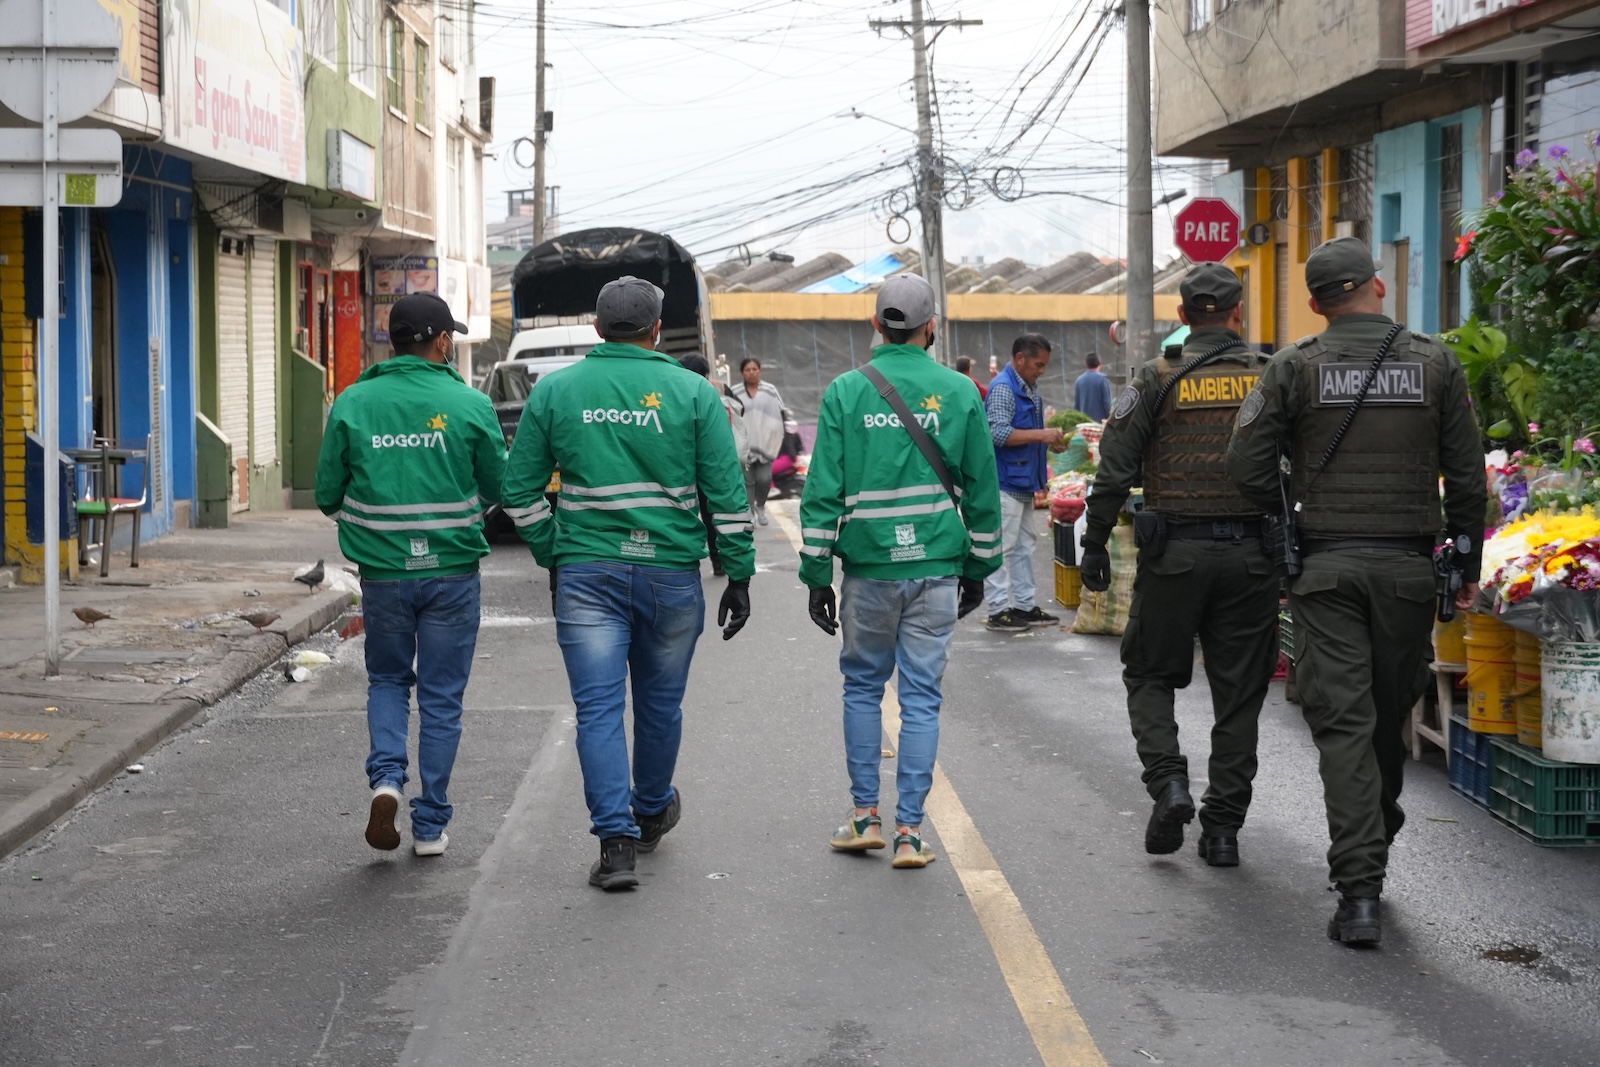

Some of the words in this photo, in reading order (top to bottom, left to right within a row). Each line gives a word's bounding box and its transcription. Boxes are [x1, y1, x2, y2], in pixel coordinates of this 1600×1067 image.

[195, 56, 207, 128] El
[244, 79, 279, 152] Sazón
[1184, 221, 1231, 242] PARE
[1179, 376, 1259, 402] AMBIENT
[864, 412, 940, 435] BOGTA
